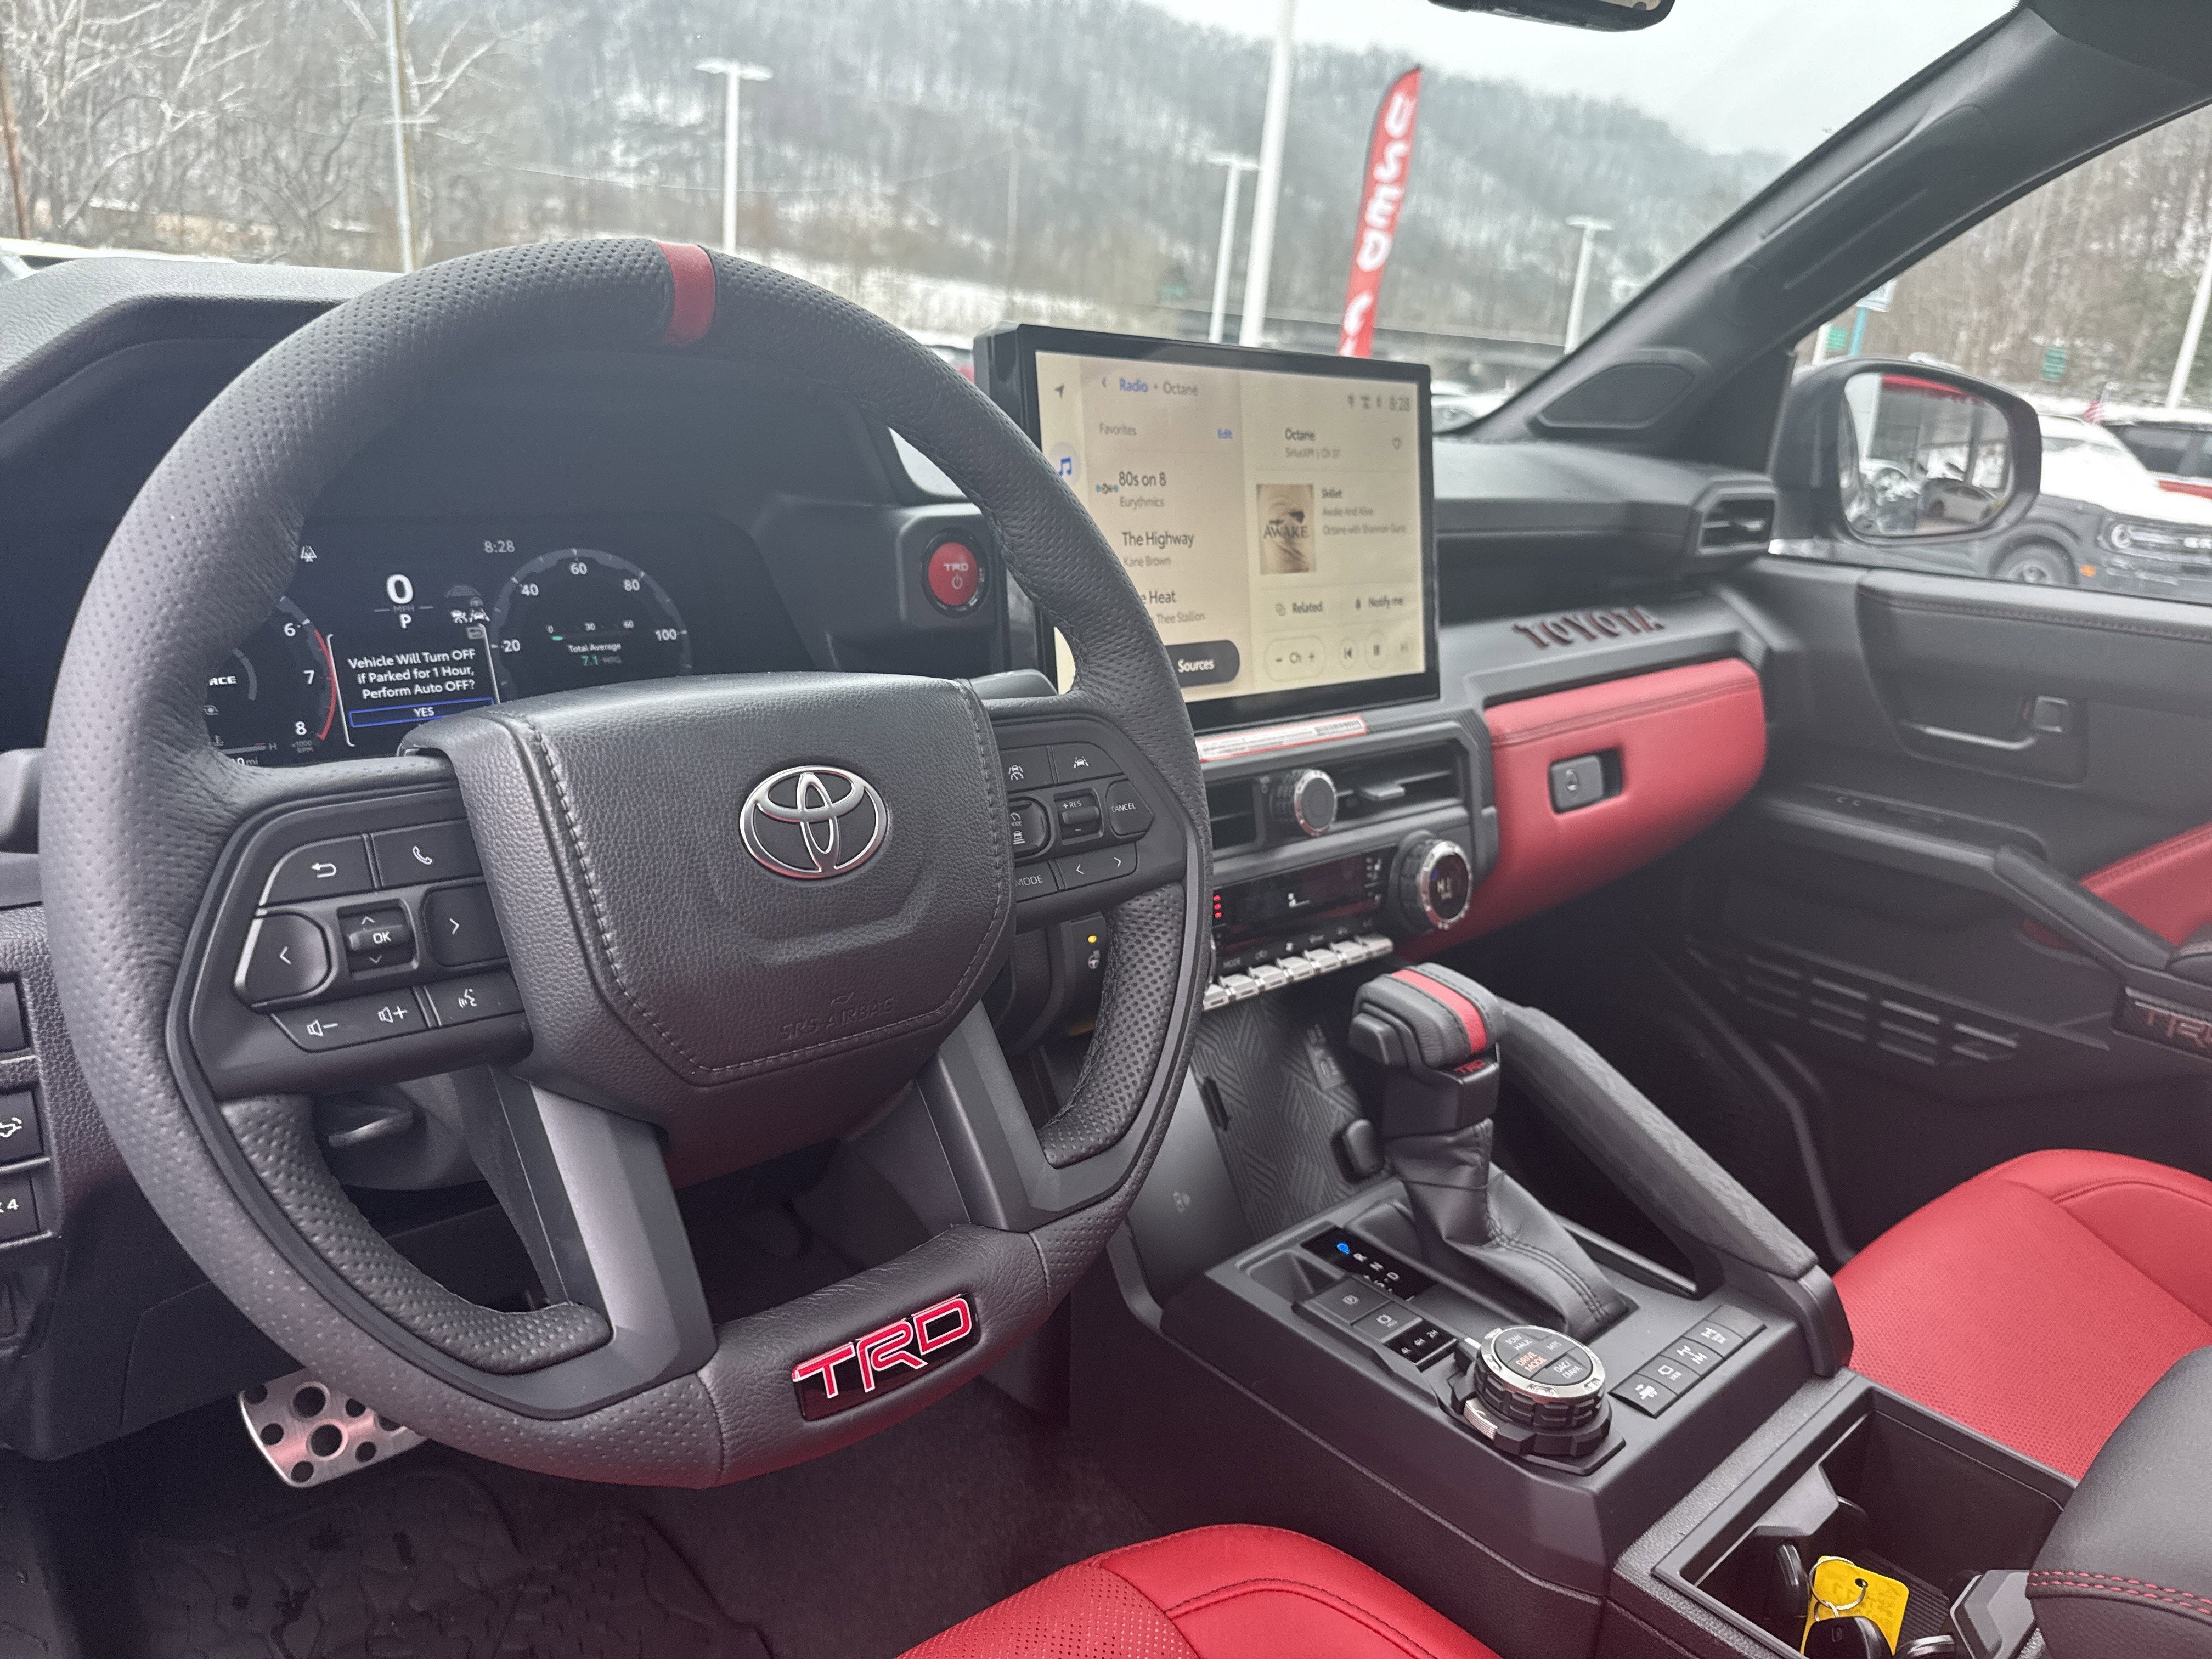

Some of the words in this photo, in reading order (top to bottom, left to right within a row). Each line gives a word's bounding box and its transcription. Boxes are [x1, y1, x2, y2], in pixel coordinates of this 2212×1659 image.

[1356, 92, 1417, 273] USED
[1119, 377, 1149, 393] Radio
[1163, 380, 1199, 396] Octane
[1389, 395, 1411, 411] 8:28
[1099, 422, 1137, 436] Favorites
[1217, 428, 1233, 439] Edit
[1285, 428, 1315, 441] Octane
[1119, 471, 1139, 487] 80s
[1142, 475, 1156, 487] on
[1159, 472, 1166, 487] 8
[1119, 496, 1164, 510] Eurythmics
[1263, 524, 1309, 539] AWAKE
[484, 540, 516, 553] 8:28
[1122, 532, 1143, 546] The
[1146, 531, 1195, 549] Highway
[569, 562, 588, 575] 60
[943, 562, 969, 572] TRD
[1124, 556, 1144, 567] Kane
[1146, 556, 1171, 567] Brown
[386, 574, 414, 604] 0
[521, 583, 539, 596] 40
[623, 579, 640, 591] 80
[1149, 590, 1177, 604] Heat
[1292, 601, 1323, 614] Related
[1368, 594, 1390, 609] Notify
[1391, 597, 1403, 606] me
[399, 613, 412, 629] P
[1156, 612, 1176, 624] Thee
[1177, 610, 1206, 623] Stallion
[284, 622, 296, 637] 6
[584, 622, 596, 631] 30
[1512, 606, 1664, 650] TOYOTA
[655, 628, 678, 641] 100
[501, 639, 521, 652] 20
[567, 644, 589, 653] Total
[590, 642, 622, 652] Average
[348, 656, 394, 669] Vehicle
[396, 652, 421, 665] Will
[422, 651, 449, 663] Turn
[451, 648, 476, 661] OFF
[580, 654, 599, 665] 7.1
[1177, 659, 1215, 673] Sources
[303, 670, 315, 685] 7
[357, 673, 366, 685] if
[369, 669, 411, 684] Parked
[413, 667, 430, 680] for
[432, 666, 439, 679] 1
[442, 665, 475, 679] Hour,
[362, 684, 411, 700] Perform
[413, 683, 443, 696] Auto
[444, 680, 475, 692] OFF?
[413, 706, 435, 718] YES
[295, 721, 307, 735] 8
[269, 742, 278, 751] H
[246, 757, 258, 766] mi
[1111, 803, 1136, 813] CANCEL
[1015, 874, 1043, 887] MODE
[373, 932, 392, 944] OK
[826, 996, 895, 1030] AIRBAG
[2134, 1003, 2212, 1048] TR
[1352, 1252, 1368, 1262] R
[1369, 1261, 1384, 1272] N
[1386, 1272, 1400, 1281] D
[792, 1295, 973, 1399] TRD
[1513, 1339, 1533, 1351] HAUL
[1545, 1340, 1562, 1351] MTS
[1515, 1350, 1537, 1367] DRIVE
[1524, 1355, 1547, 1373] MODE
[1562, 1364, 1583, 1379] CRAWL
